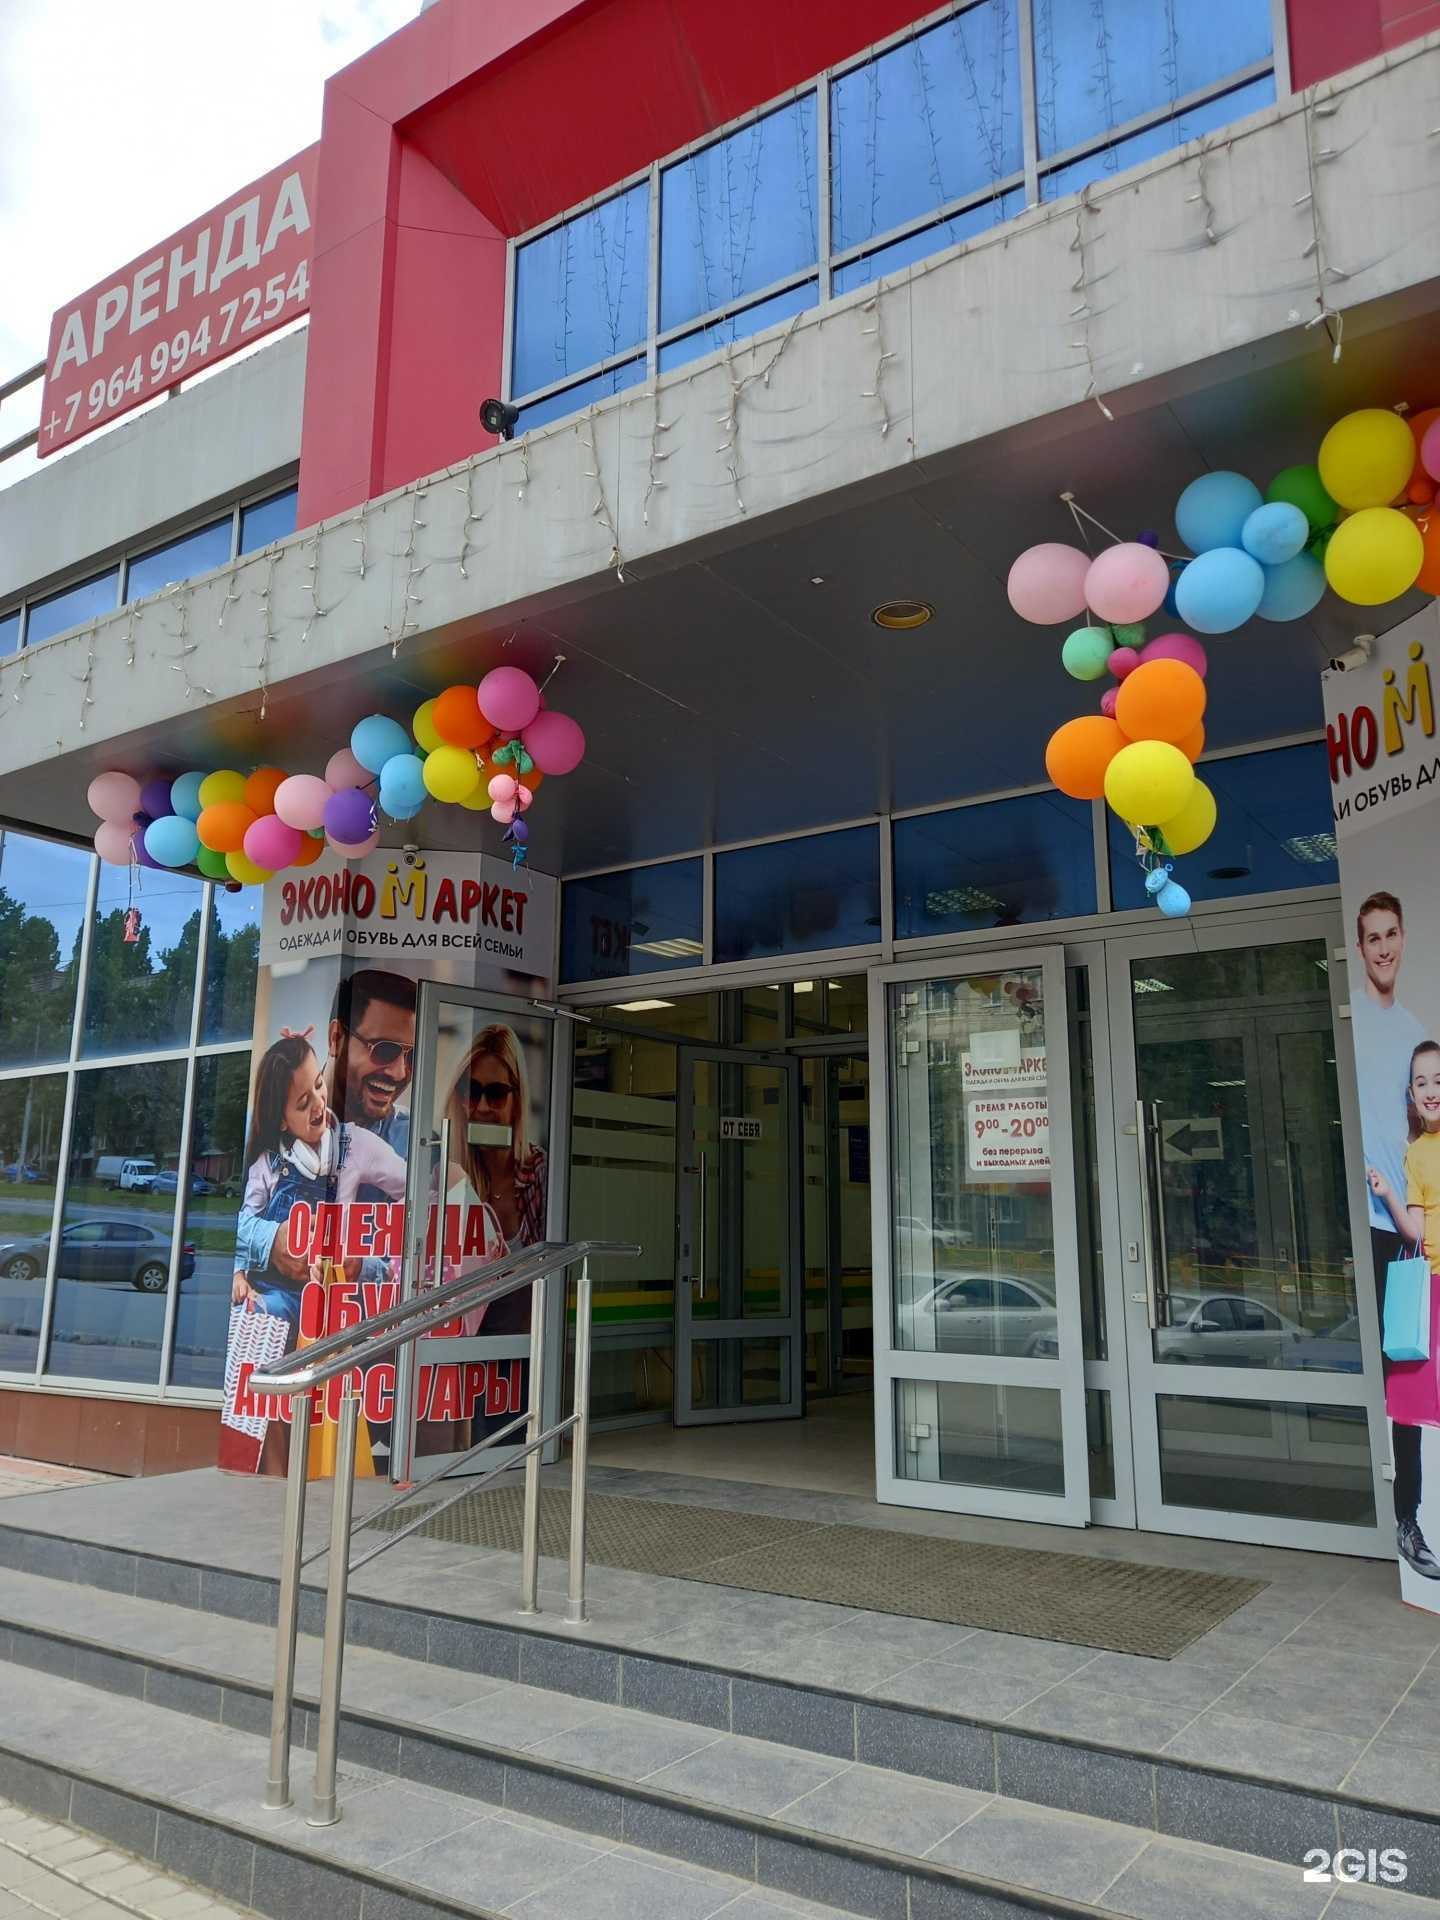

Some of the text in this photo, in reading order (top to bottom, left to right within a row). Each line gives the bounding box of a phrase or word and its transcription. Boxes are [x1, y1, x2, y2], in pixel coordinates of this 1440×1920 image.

[51, 171, 311, 382] АРЕНДА
[44, 260, 310, 439] +7 964 994 7254
[1354, 773, 1412, 813] ОБУВЬ
[279, 928, 523, 960] ОДЕЖДА И ОБУВЬ ДЛЯ ВСЕЙ СЕМЬИ
[975, 1101, 1048, 1113] ВРЕМЯ РАБОТЫ
[723, 1121, 760, 1137] ОТ СЕБЯ
[982, 1147, 998, 1156] без
